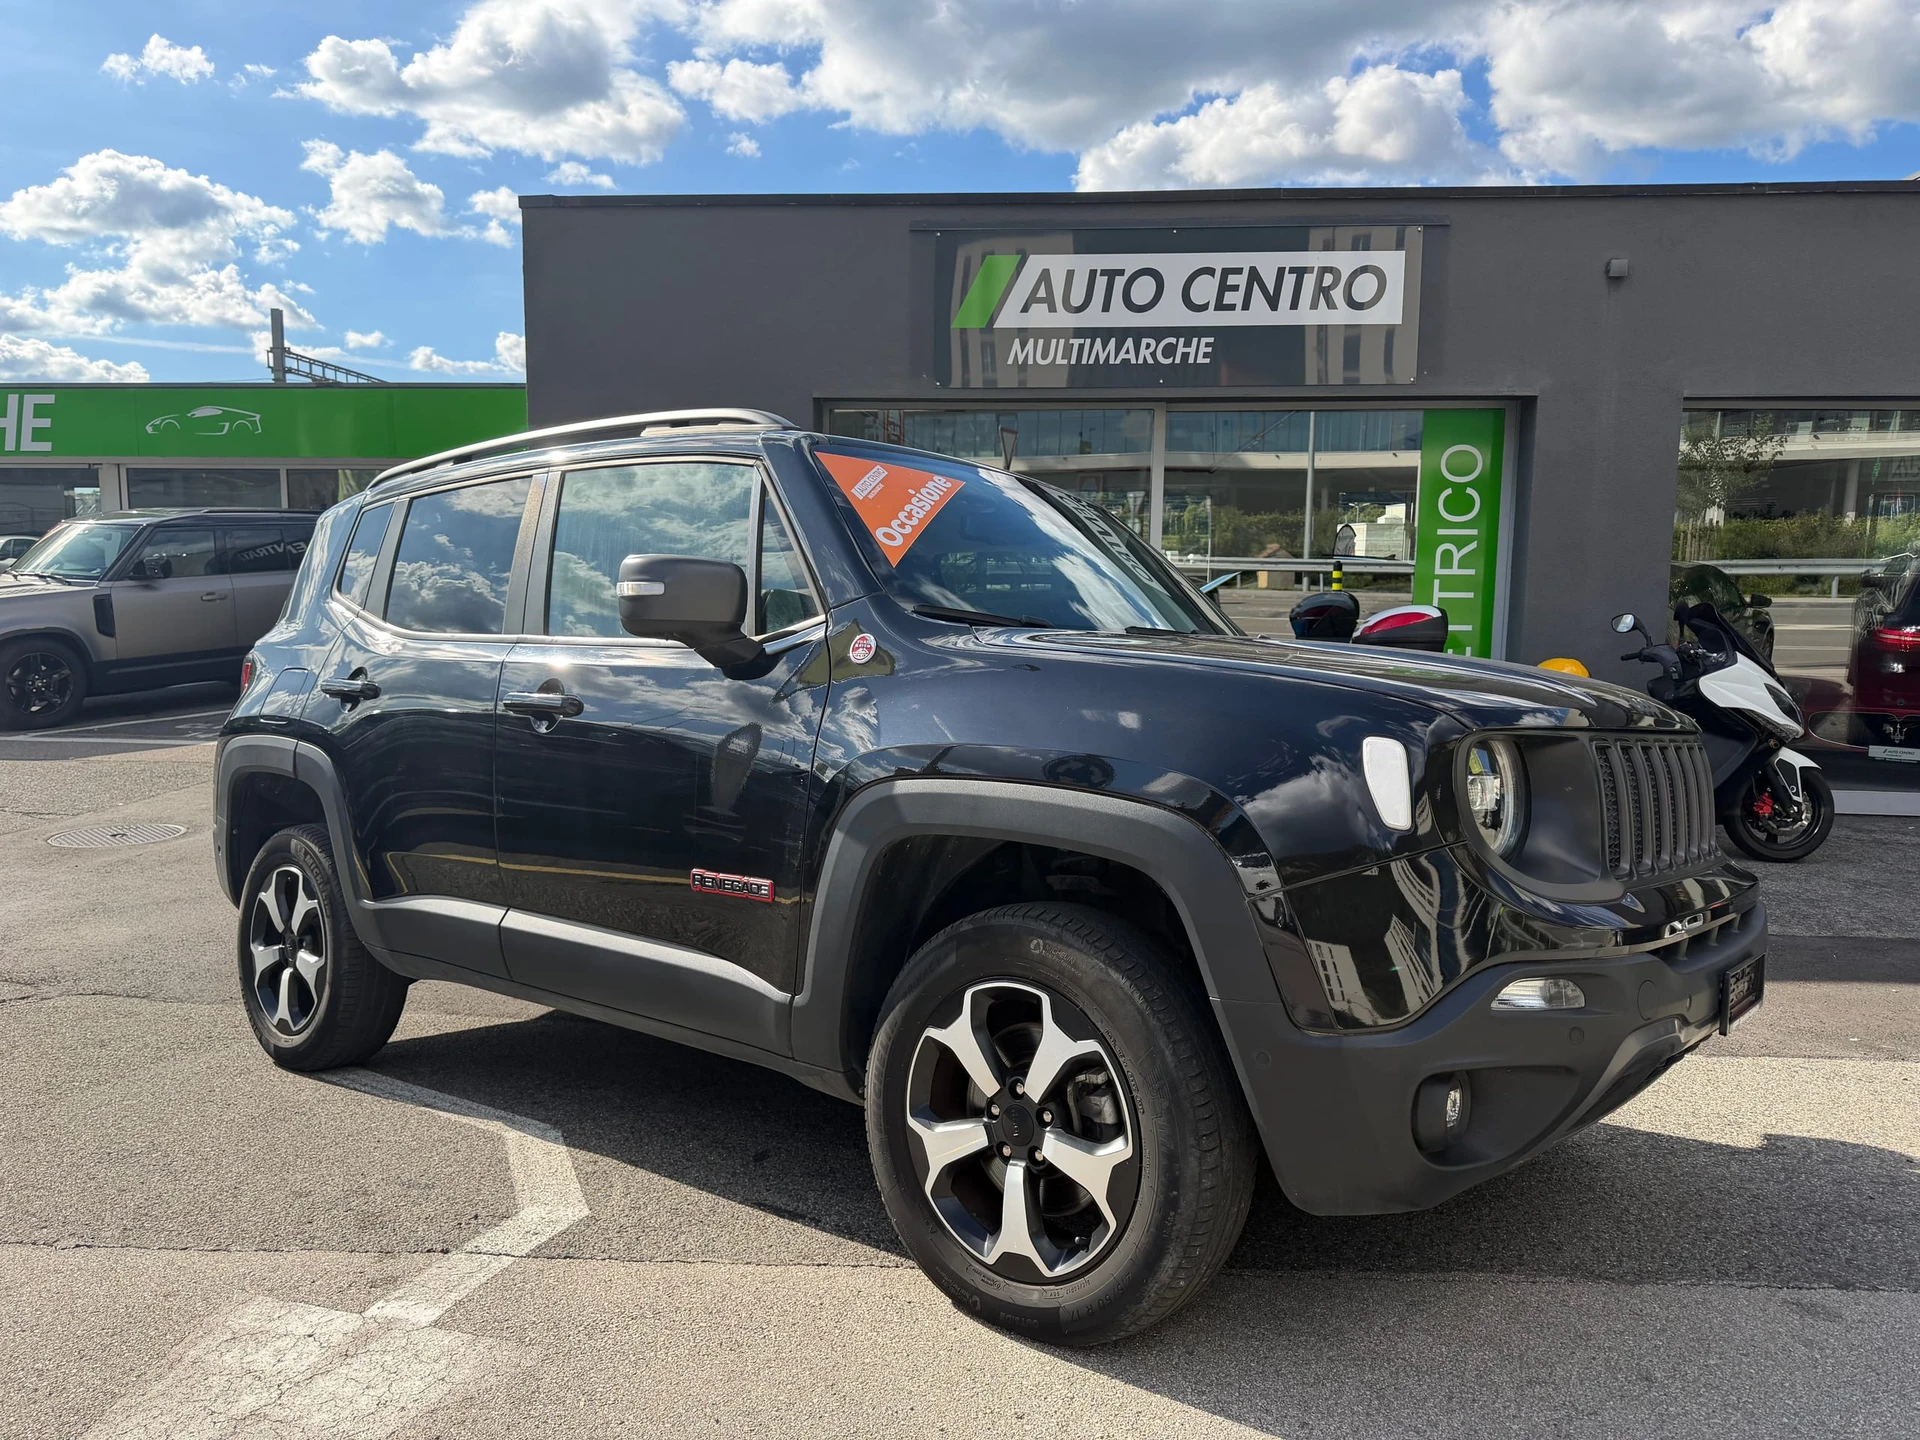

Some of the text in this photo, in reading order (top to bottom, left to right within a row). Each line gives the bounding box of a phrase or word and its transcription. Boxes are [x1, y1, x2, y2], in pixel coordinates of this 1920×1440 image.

[1019, 264, 1388, 314] AUTO CENTRO
[1007, 337, 1215, 365] MULTIMARCHE
[875, 475, 952, 547] Occasione
[690, 868, 775, 903] RENEGADE
